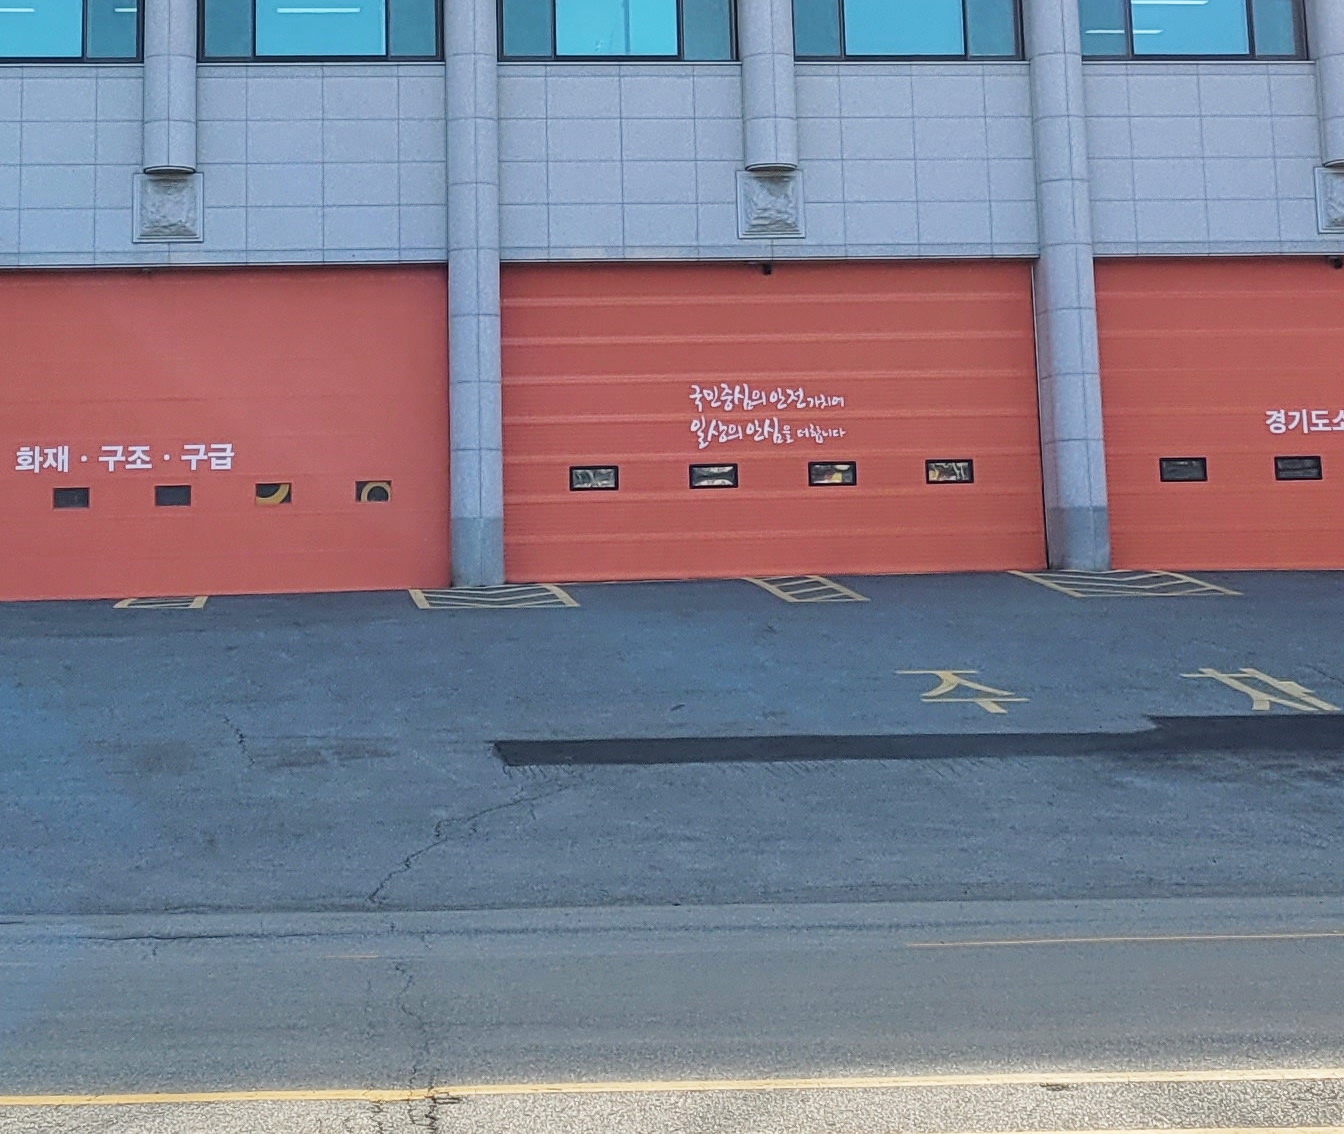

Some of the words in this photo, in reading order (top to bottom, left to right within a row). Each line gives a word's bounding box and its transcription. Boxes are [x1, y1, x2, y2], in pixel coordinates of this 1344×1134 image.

[689, 383, 767, 412] 국민중심의
[690, 416, 743, 449] 일상의
[746, 417, 794, 444] 안심을
[796, 423, 847, 444] 더합니다
[14, 445, 70, 474] 화재
[98, 445, 153, 472] 구조
[180, 442, 235, 471] 구급
